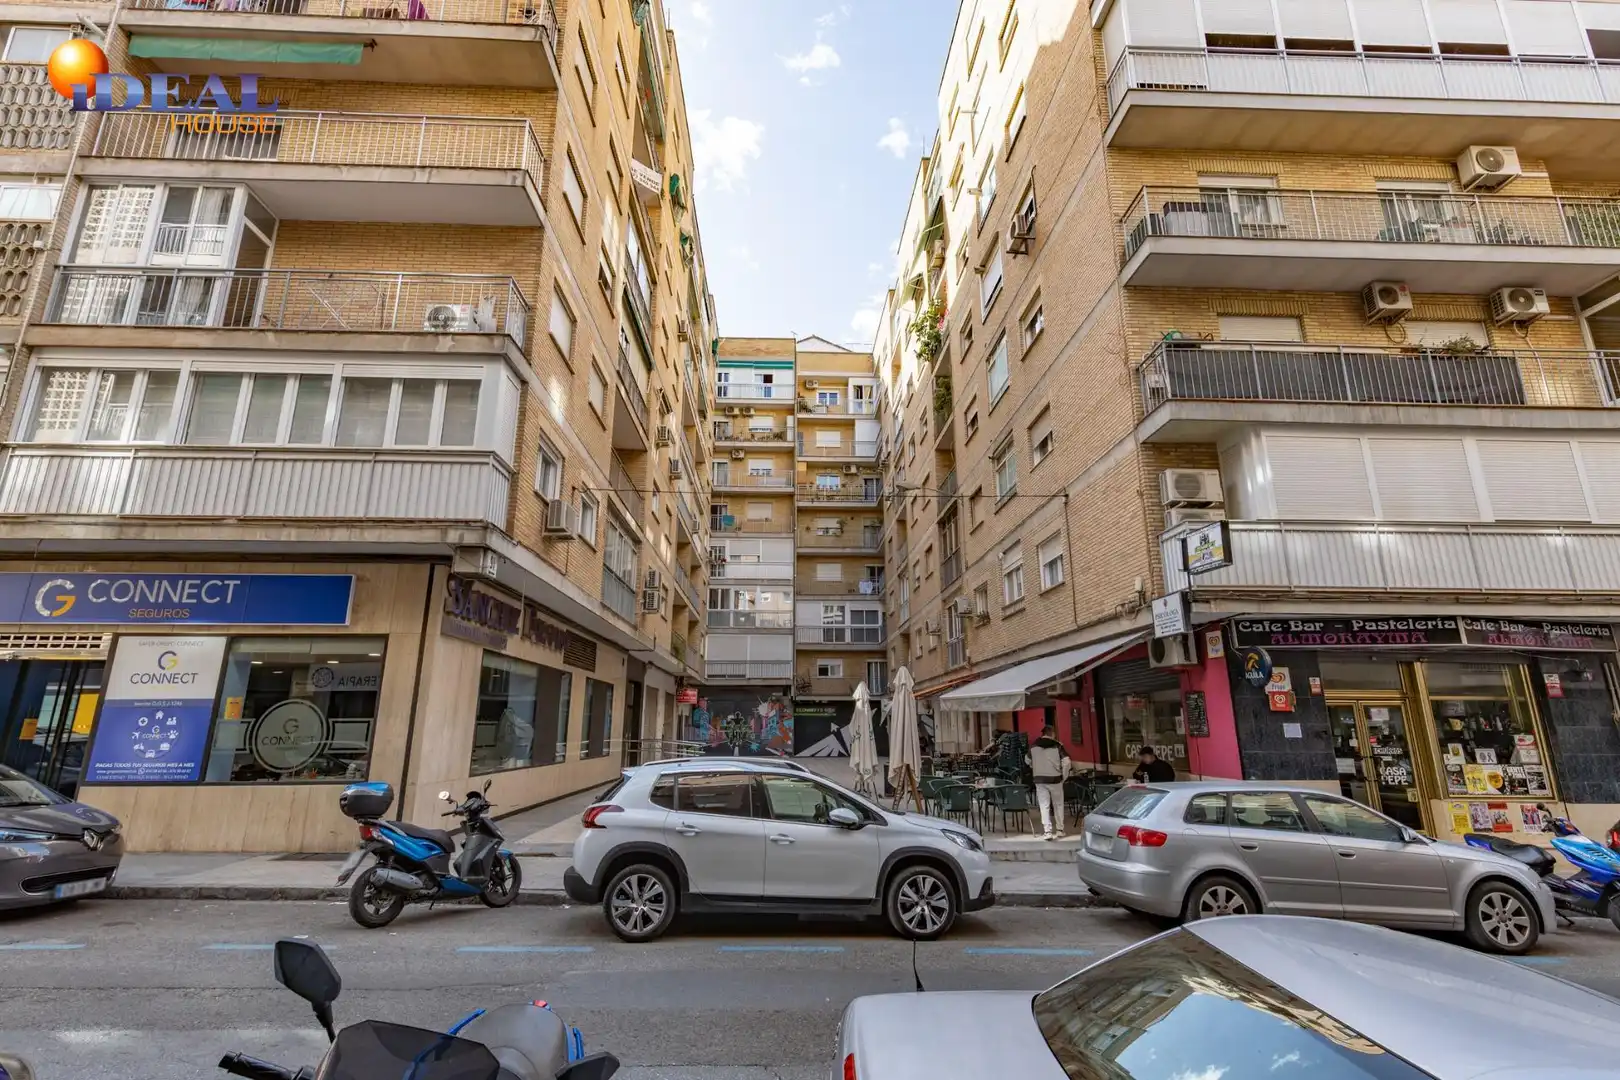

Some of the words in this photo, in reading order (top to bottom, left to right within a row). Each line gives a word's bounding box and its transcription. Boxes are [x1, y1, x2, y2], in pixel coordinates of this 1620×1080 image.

[87, 579, 241, 604] CONNECT
[128, 608, 190, 619] SEGUROS
[130, 672, 198, 685] CONNECT
